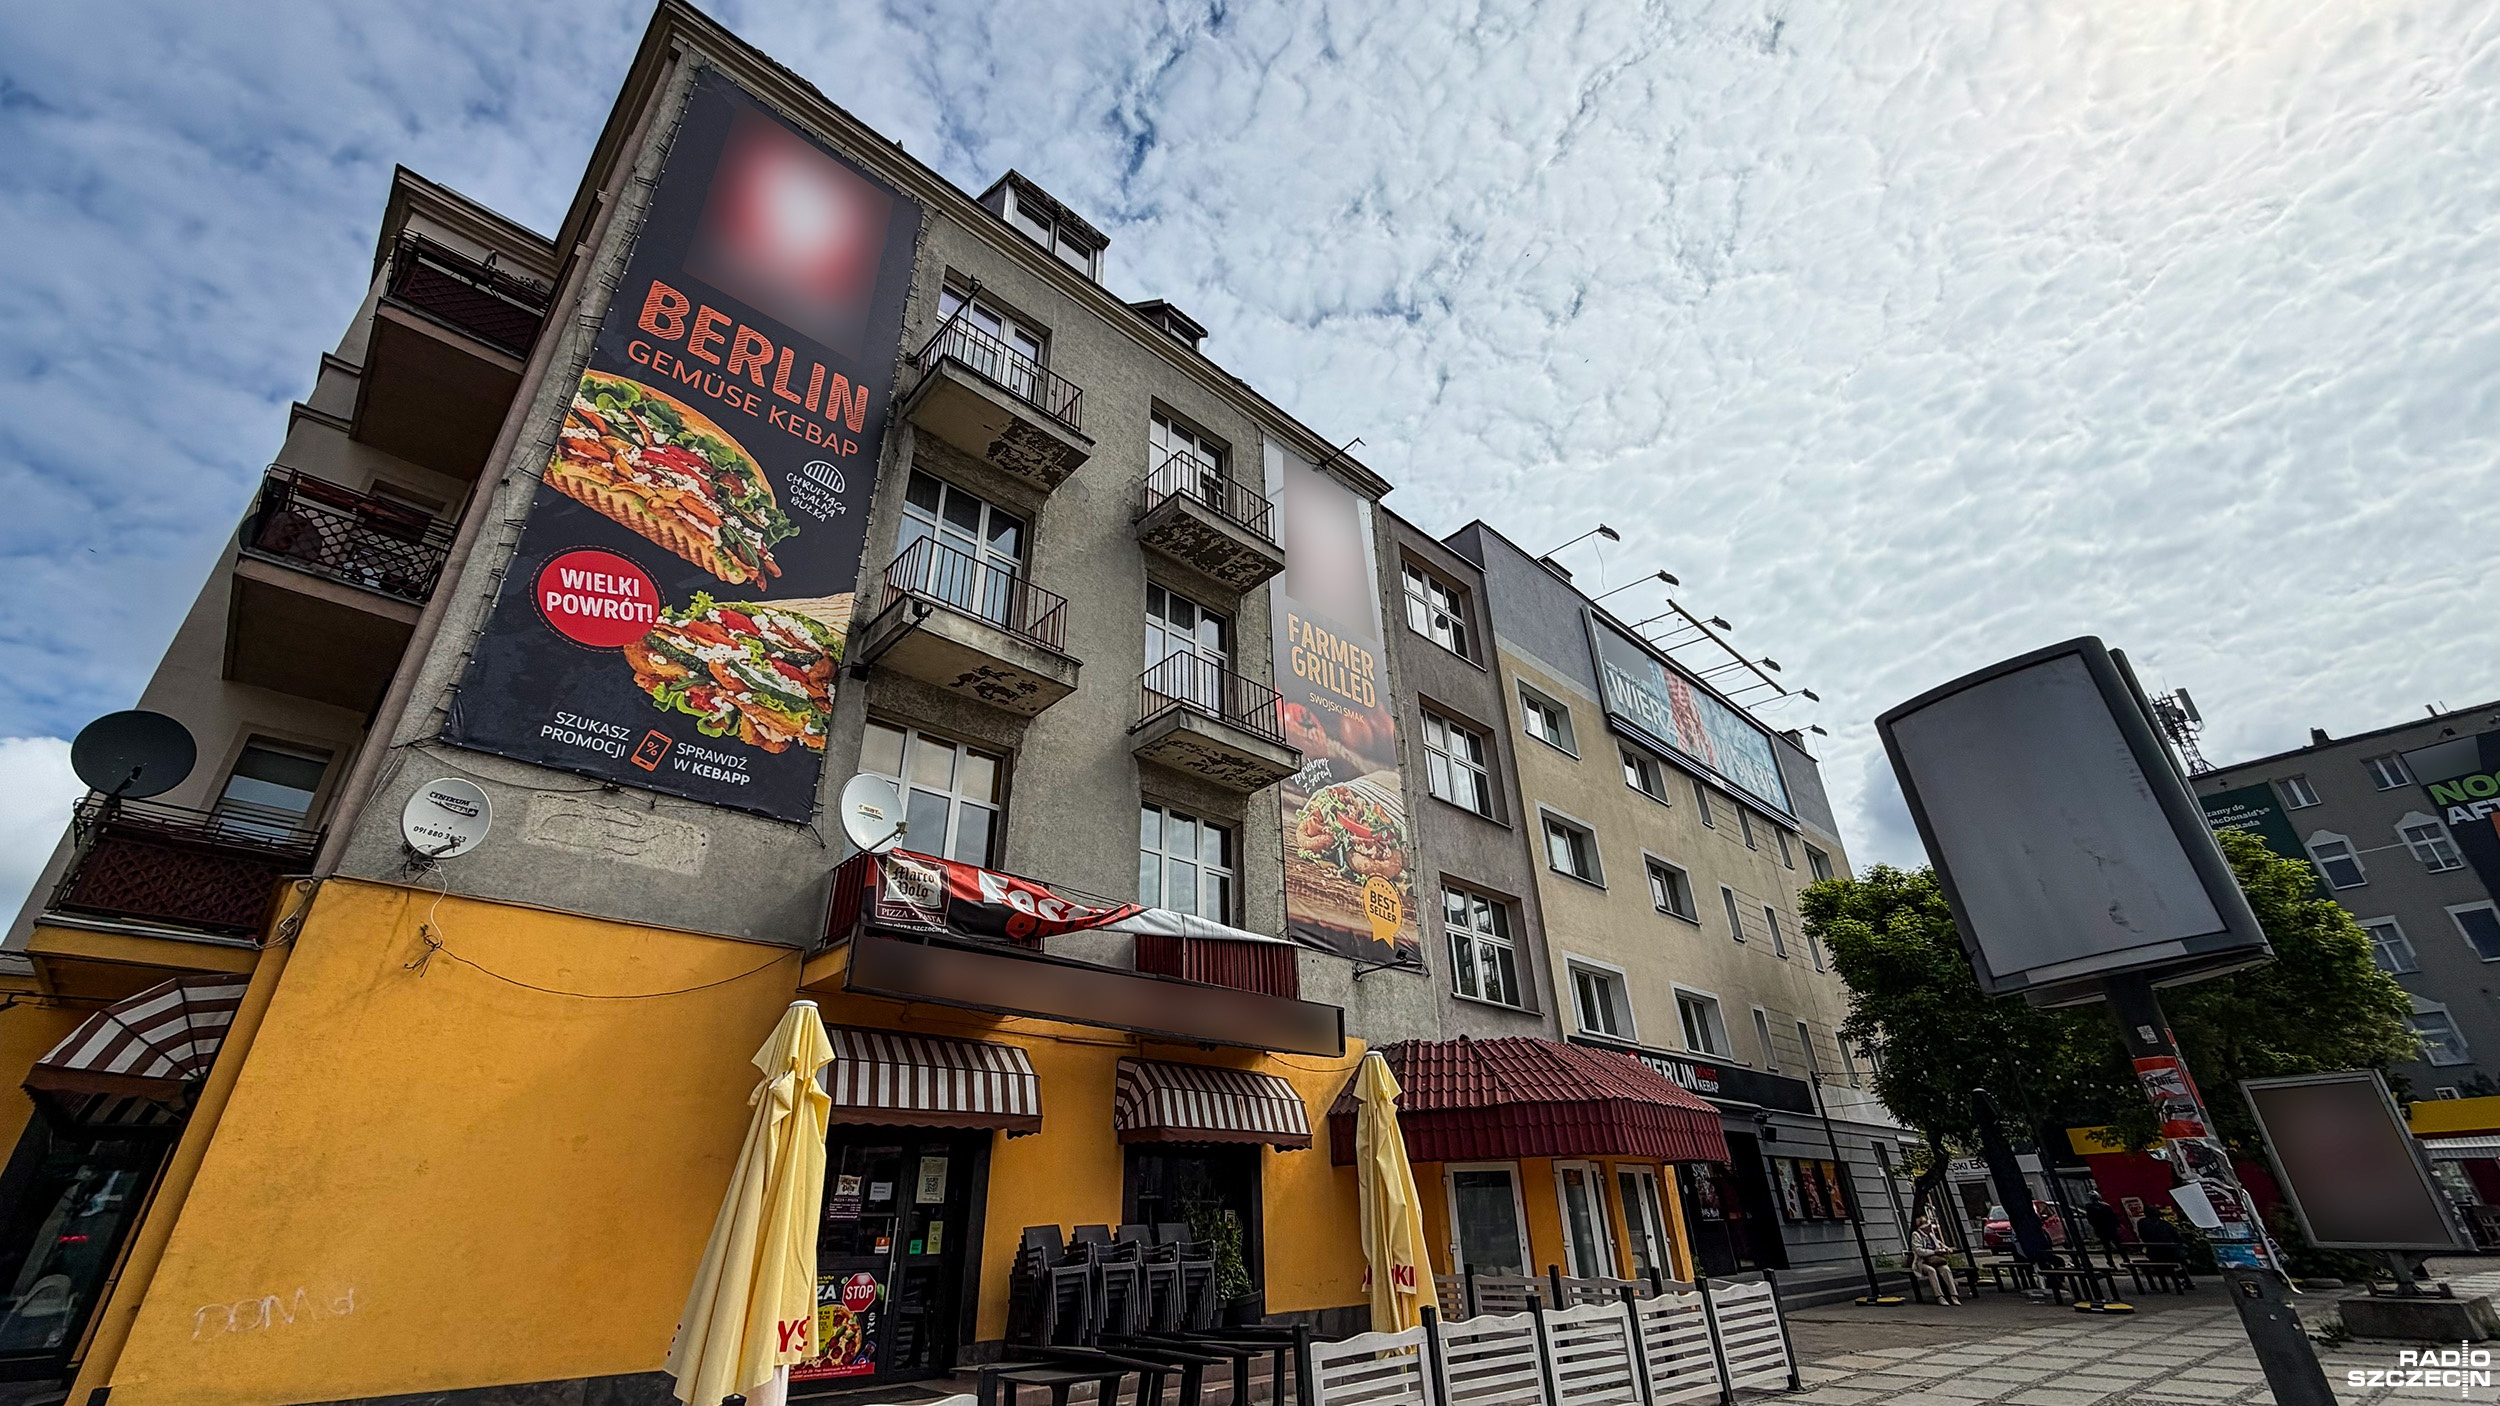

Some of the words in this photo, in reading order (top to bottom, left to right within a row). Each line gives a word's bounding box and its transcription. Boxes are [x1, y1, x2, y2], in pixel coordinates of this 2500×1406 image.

[638, 280, 869, 433] BERLIN
[628, 340, 762, 417] GEMÜSE
[768, 405, 858, 457] KEBAP
[790, 485, 836, 518] OWALNA
[560, 568, 640, 597] WIELKI
[546, 591, 653, 623] POWRÓT!
[1288, 612, 1375, 681] FARMER
[1291, 645, 1376, 708] GRILLED
[1309, 692, 1342, 714] SWOJSKI
[1343, 707, 1365, 725] SMAK
[554, 711, 631, 741] SZUKASZ
[540, 725, 626, 759] PROMOCJI
[676, 742, 748, 771] SPRAWDŹ
[674, 757, 690, 772] W
[692, 765, 751, 786] KEBAPP
[2428, 771, 2500, 805] NO
[2232, 804, 2245, 812] do
[428, 829, 444, 839] 880
[892, 866, 935, 884] Marco
[881, 908, 908, 918] PIZZA
[1370, 890, 1397, 912] BEST
[1370, 904, 1397, 924] SELLER
[1698, 1079, 1719, 1093] KEBAP
[845, 1284, 874, 1301] STOP
